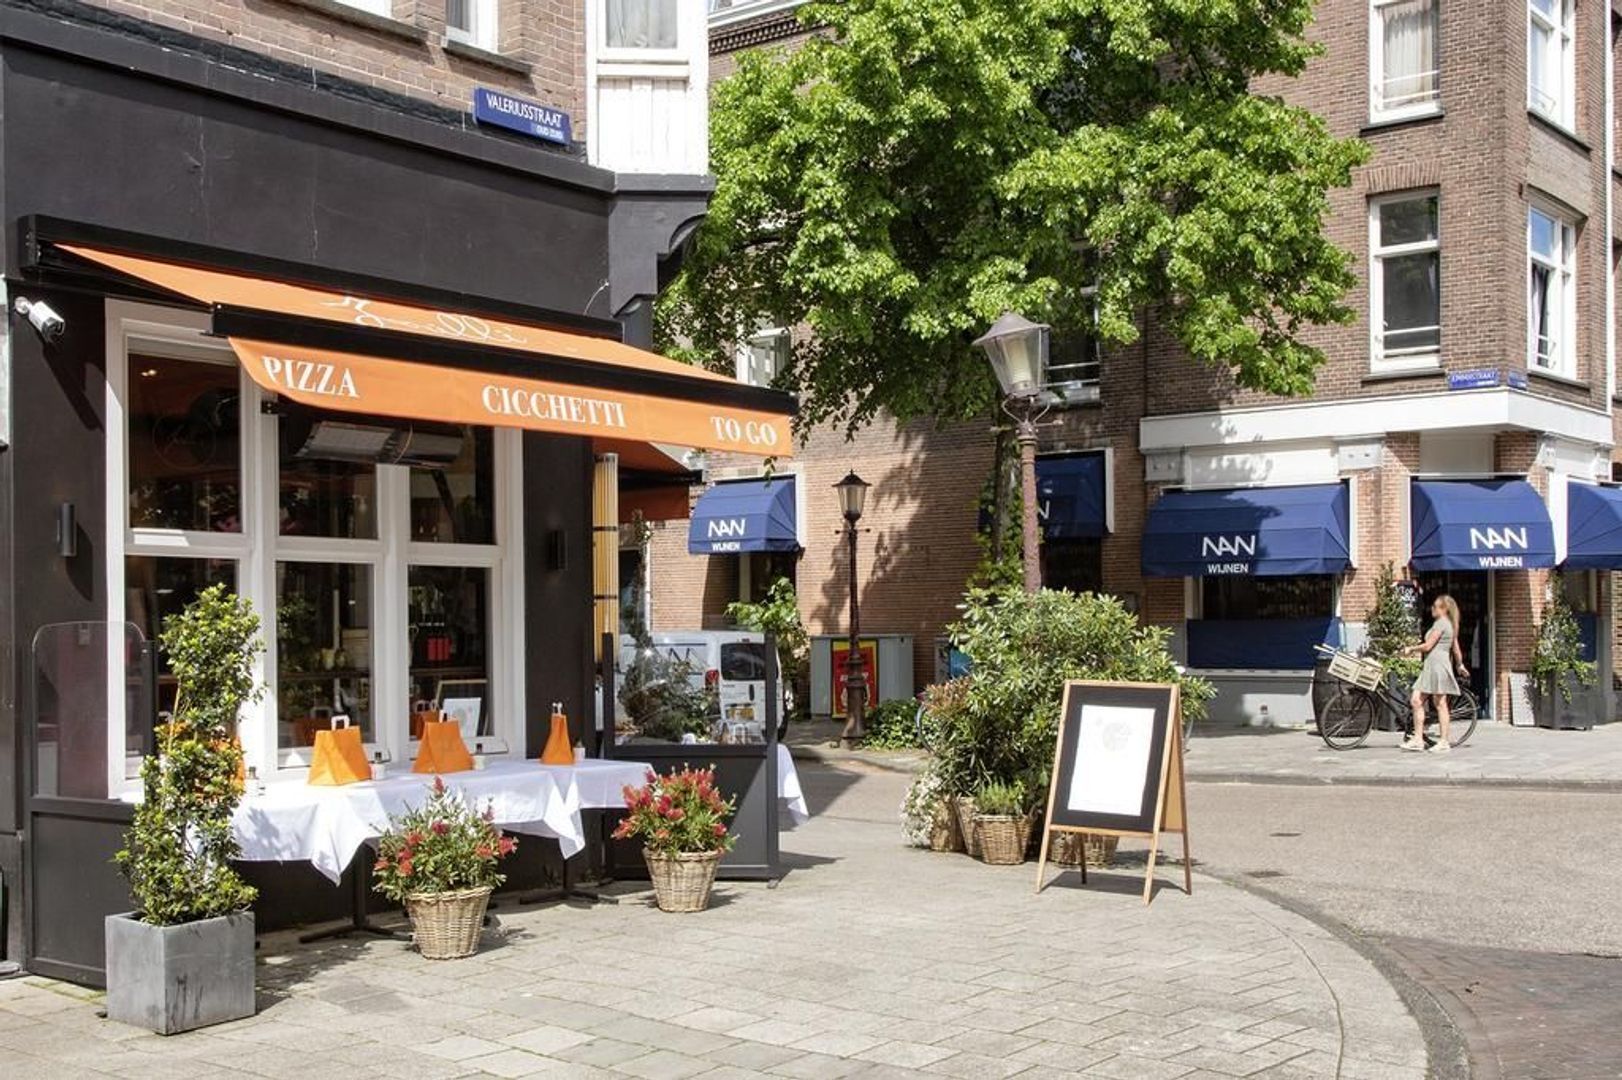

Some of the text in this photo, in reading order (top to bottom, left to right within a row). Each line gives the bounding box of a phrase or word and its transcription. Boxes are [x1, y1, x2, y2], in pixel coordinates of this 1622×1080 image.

[486, 92, 562, 128] VALERIUSSTRAAT
[262, 355, 778, 446] PIZZA CICCHETTI TO GO
[707, 518, 746, 538] NAN
[1469, 527, 1528, 549] NAN
[1201, 535, 1256, 557] NAN
[1207, 563, 1249, 574] WIJNEN
[1478, 556, 1523, 567] WIJNEN
